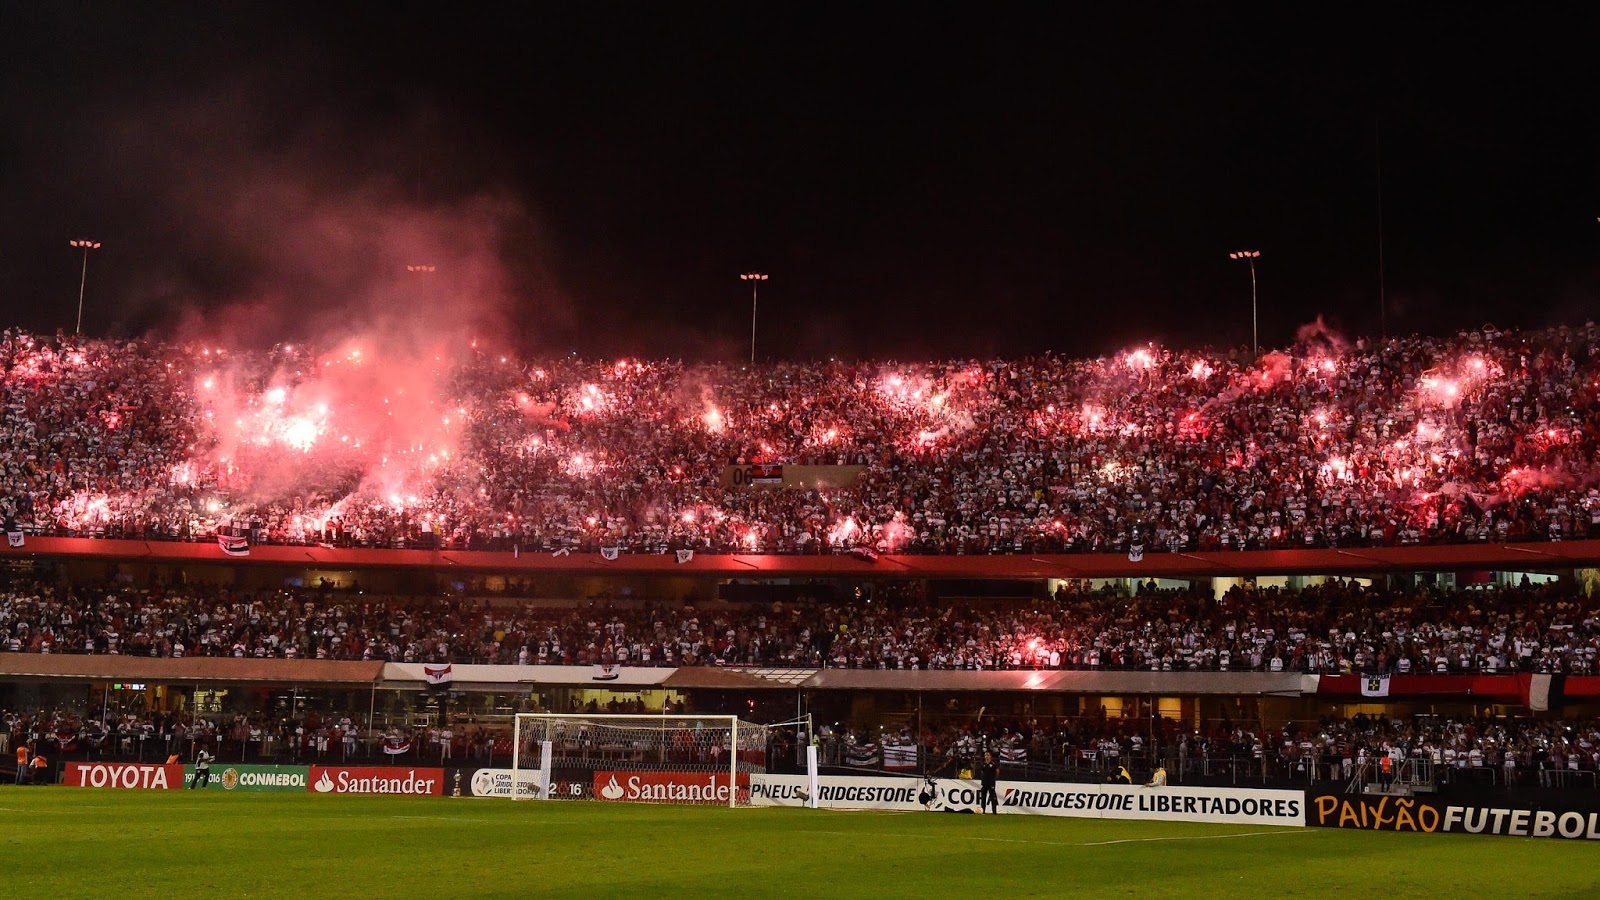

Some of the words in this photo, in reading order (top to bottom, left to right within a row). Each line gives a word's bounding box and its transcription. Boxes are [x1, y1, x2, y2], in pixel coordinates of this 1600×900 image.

[78, 765, 168, 789] TOYOTA
[240, 773, 305, 786] CONMEBOL
[337, 770, 435, 794] Santander
[627, 775, 740, 801] Santander
[751, 784, 802, 799] PNEUS
[806, 784, 917, 803] RIDGESTONE
[1002, 788, 1135, 811] BRIDGESTONE
[1139, 795, 1299, 817] LIBERTADORES
[1314, 795, 1440, 833] PAIXÃO
[1443, 806, 1600, 840] FUTEBOL
